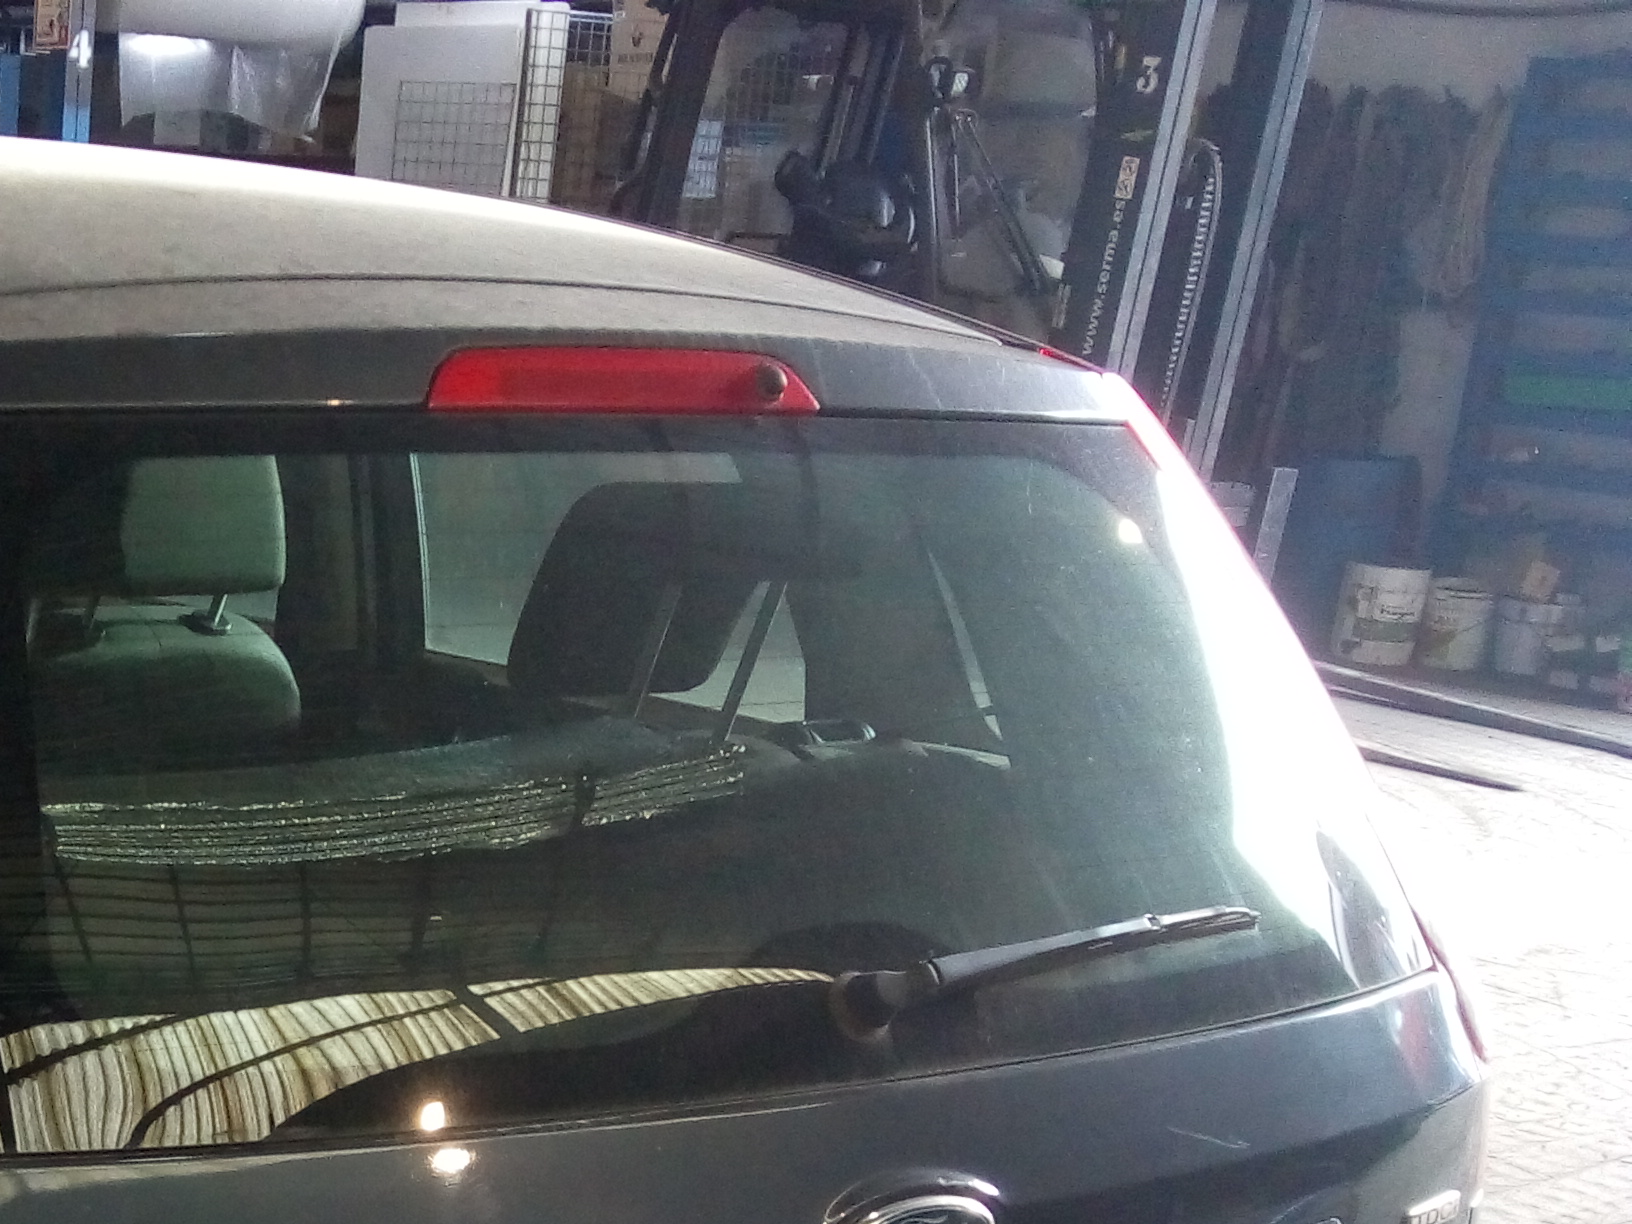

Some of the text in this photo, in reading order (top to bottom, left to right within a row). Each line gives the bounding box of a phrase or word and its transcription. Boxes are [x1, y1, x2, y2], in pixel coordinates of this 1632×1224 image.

[69, 30, 92, 68] 4
[1136, 55, 1162, 94] 3
[1082, 201, 1126, 355] www.serma.es
